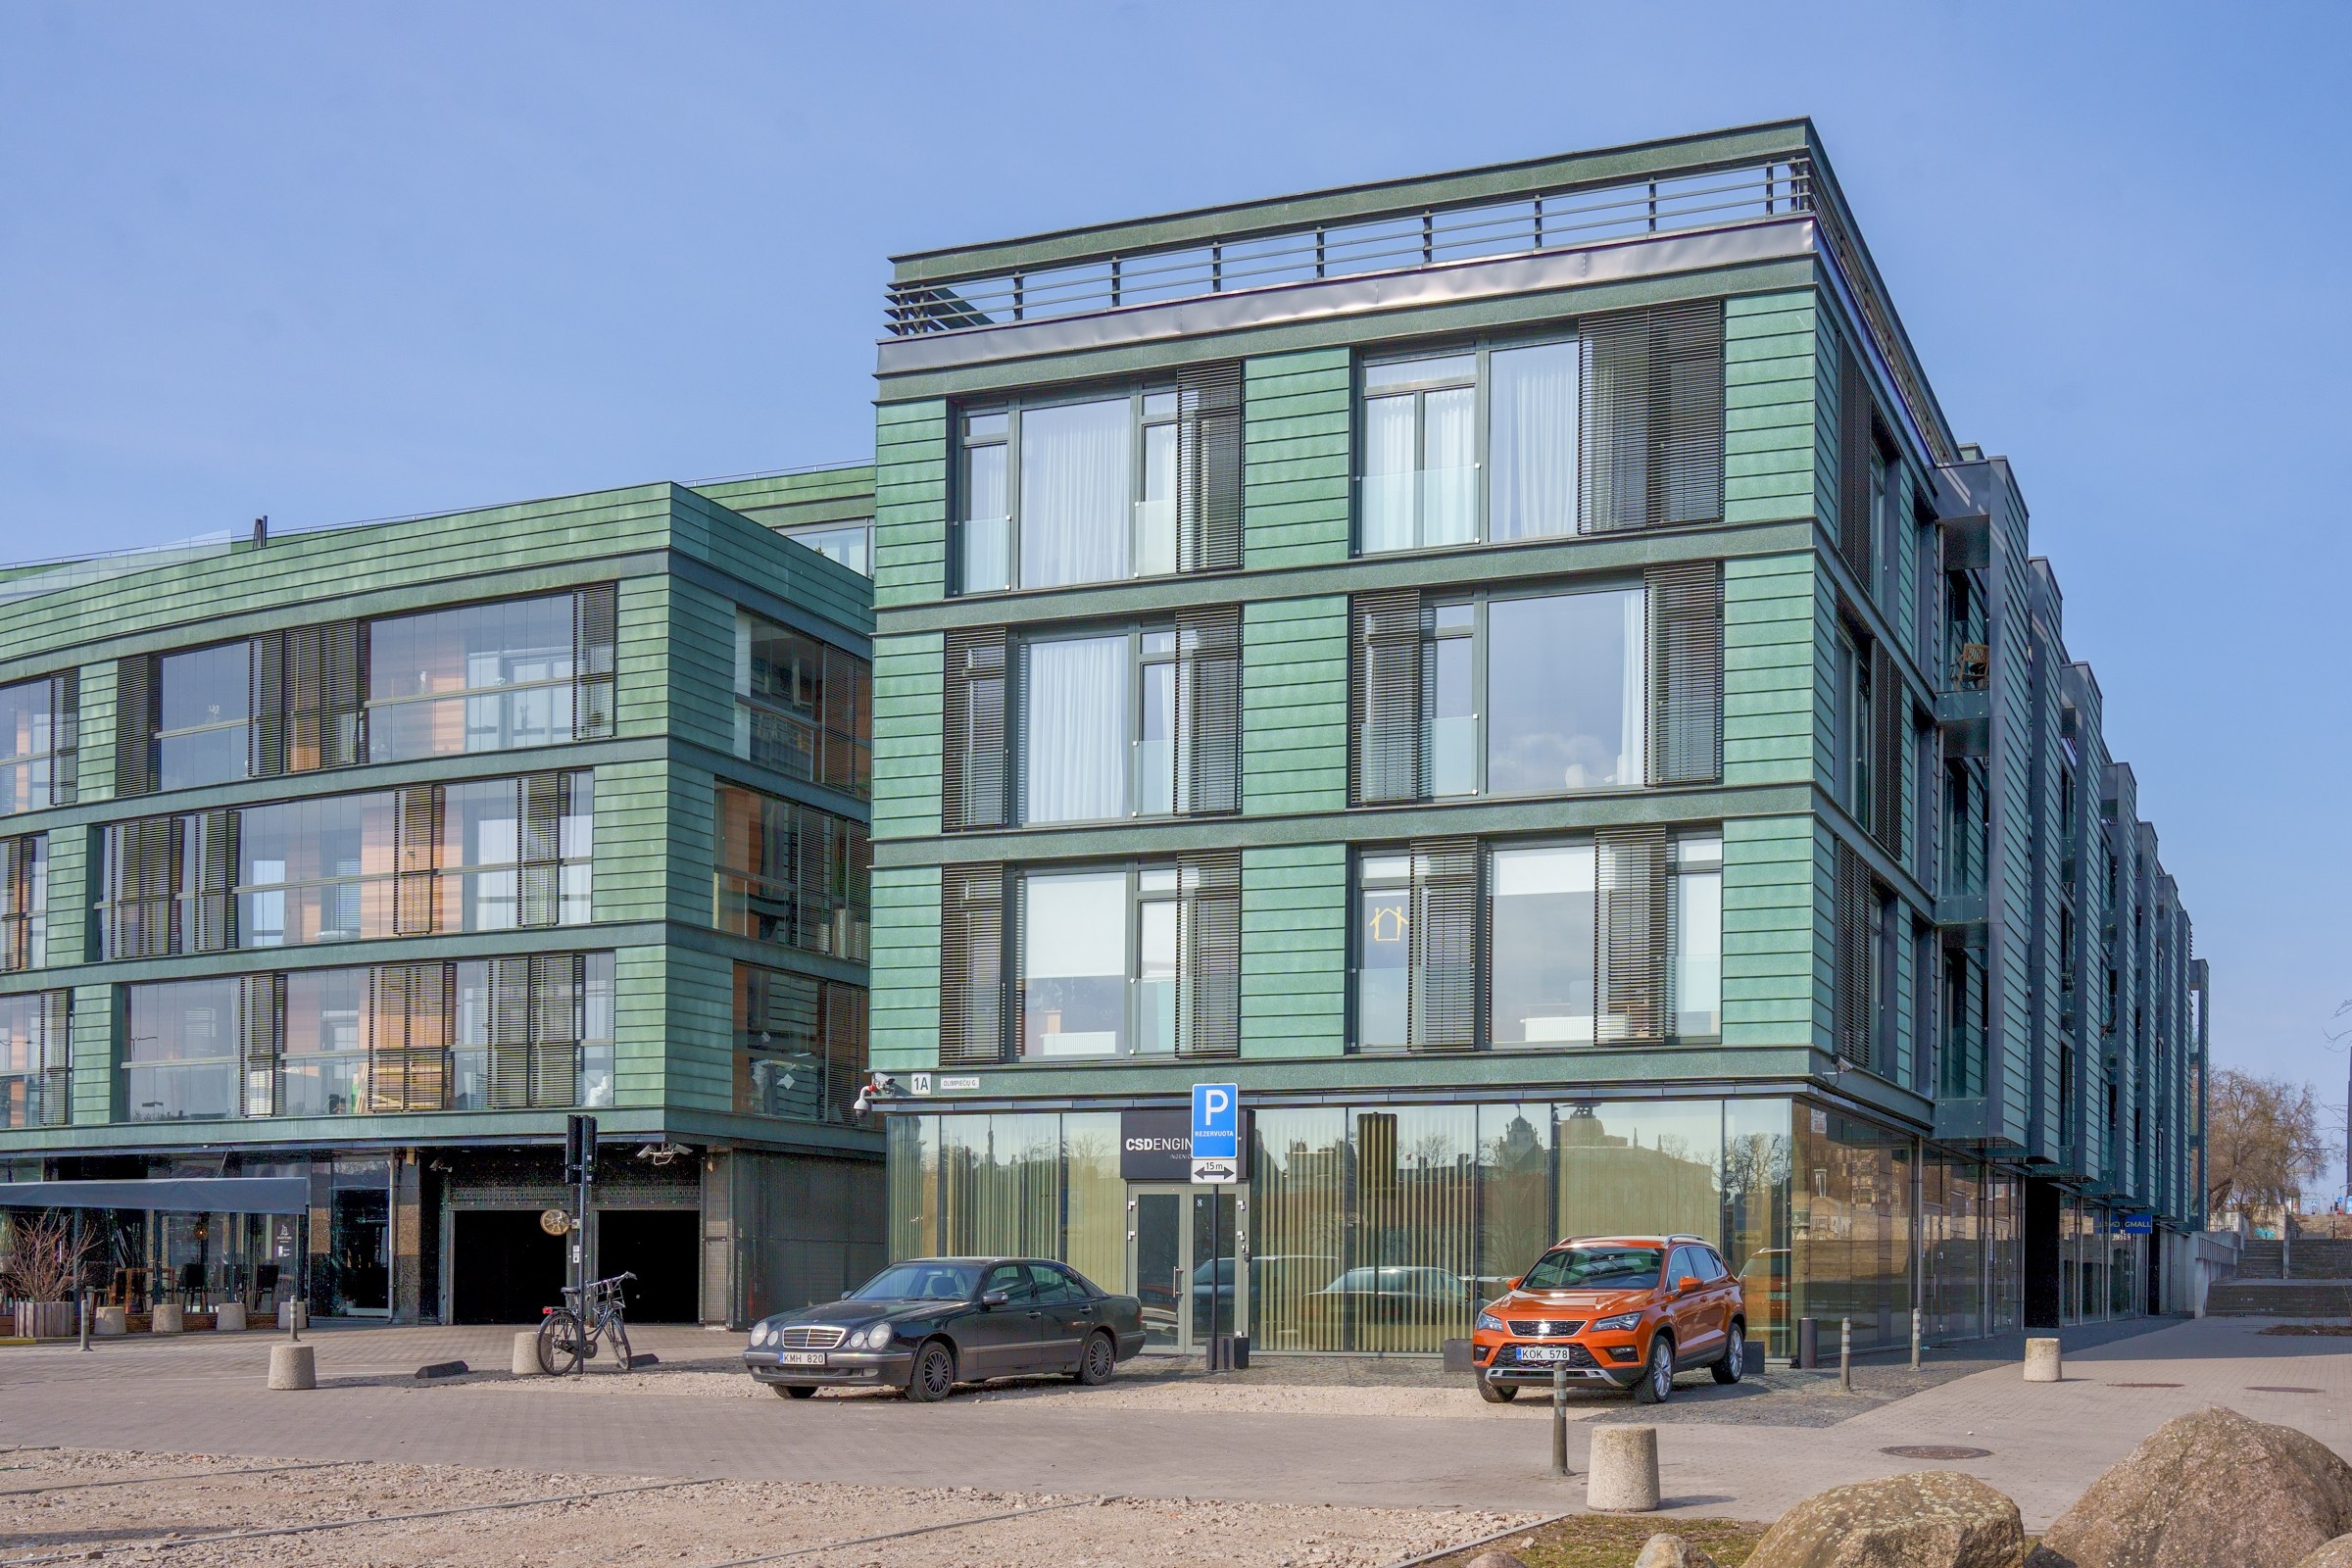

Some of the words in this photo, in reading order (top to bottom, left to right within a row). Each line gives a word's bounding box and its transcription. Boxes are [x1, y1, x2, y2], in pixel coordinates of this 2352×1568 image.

[913, 1076, 929, 1091] 1A
[1204, 1089, 1230, 1126] P
[1125, 1137, 1193, 1152] CSDENGIN
[1197, 1199, 1202, 1207] 8
[783, 1353, 802, 1363] KMH
[807, 1353, 824, 1364] 820
[1522, 1349, 1544, 1359] KOK
[1549, 1349, 1568, 1359] 578
